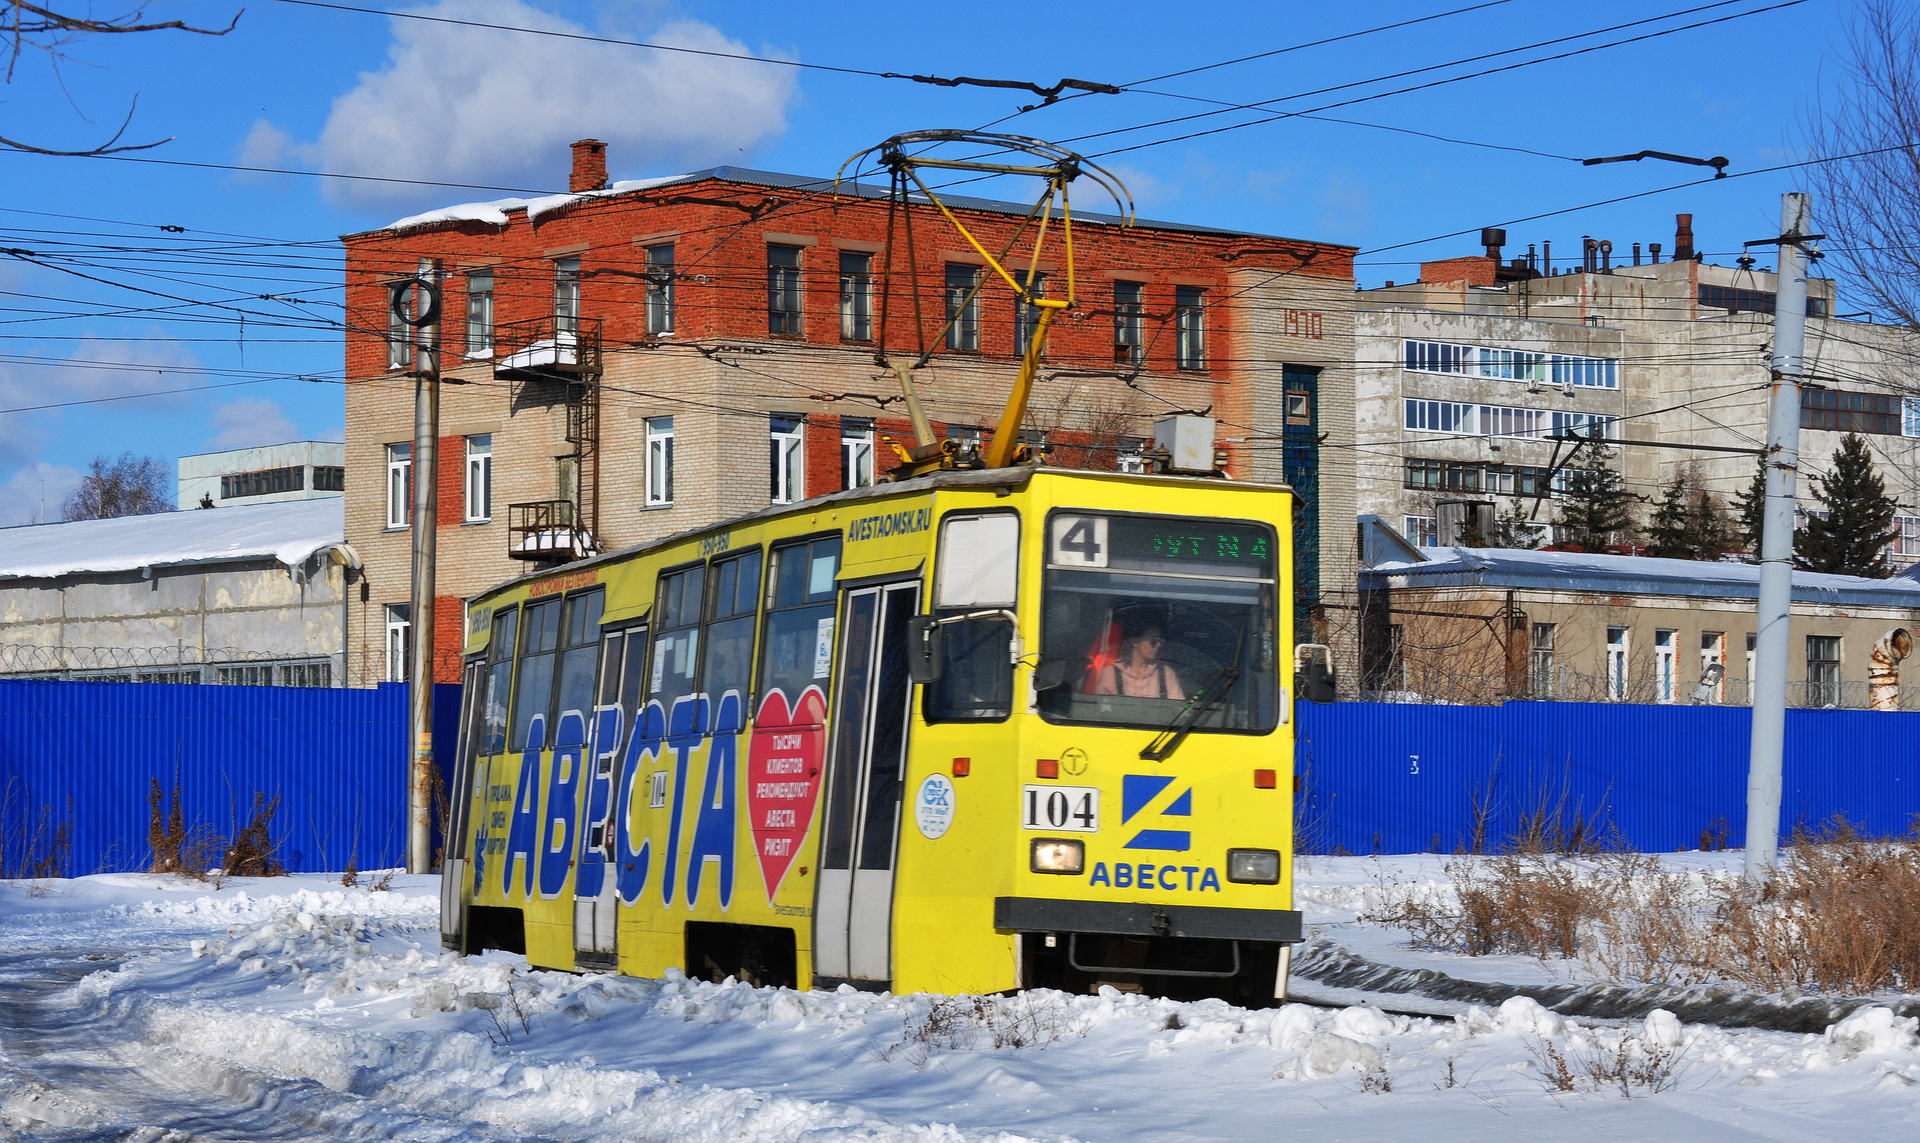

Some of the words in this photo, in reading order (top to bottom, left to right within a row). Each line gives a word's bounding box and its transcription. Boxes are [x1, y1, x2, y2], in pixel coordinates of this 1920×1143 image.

[1285, 309, 1323, 339] 1970
[847, 507, 932, 542] AVESTAOMSK.RU
[1060, 517, 1101, 562] 4
[772, 735, 802, 750] ТЫСЯЧИ
[766, 758, 804, 774] КЛИЕНТОВ
[503, 689, 740, 913] АВЕСТА
[651, 774, 668, 806] 104
[765, 809, 796, 828] АВЕСТА
[1025, 790, 1095, 829] 104
[763, 838, 792, 857] РИЭЛТ
[1089, 862, 1221, 893] АВЕСТА
